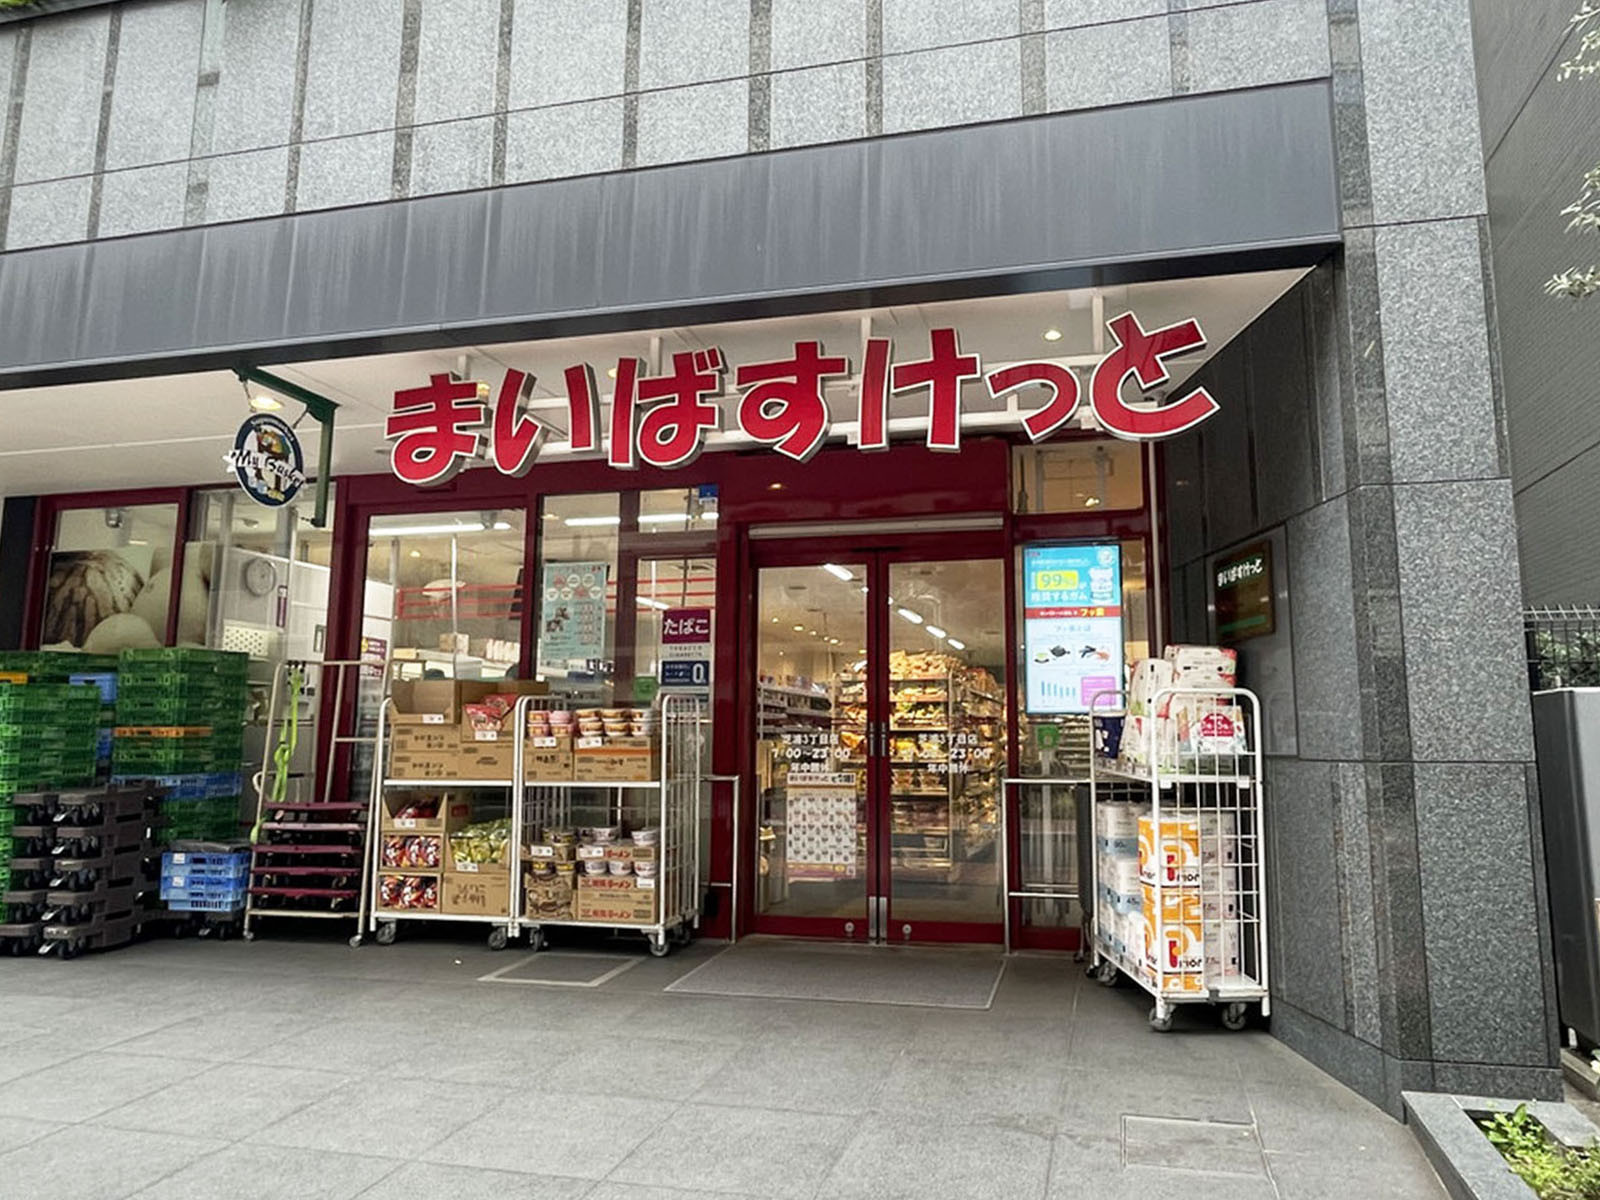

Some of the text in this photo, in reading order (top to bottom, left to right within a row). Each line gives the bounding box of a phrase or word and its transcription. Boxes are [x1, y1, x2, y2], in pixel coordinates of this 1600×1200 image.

[386, 311, 1220, 486] まいばすけっと
[664, 618, 709, 635] たばこ
